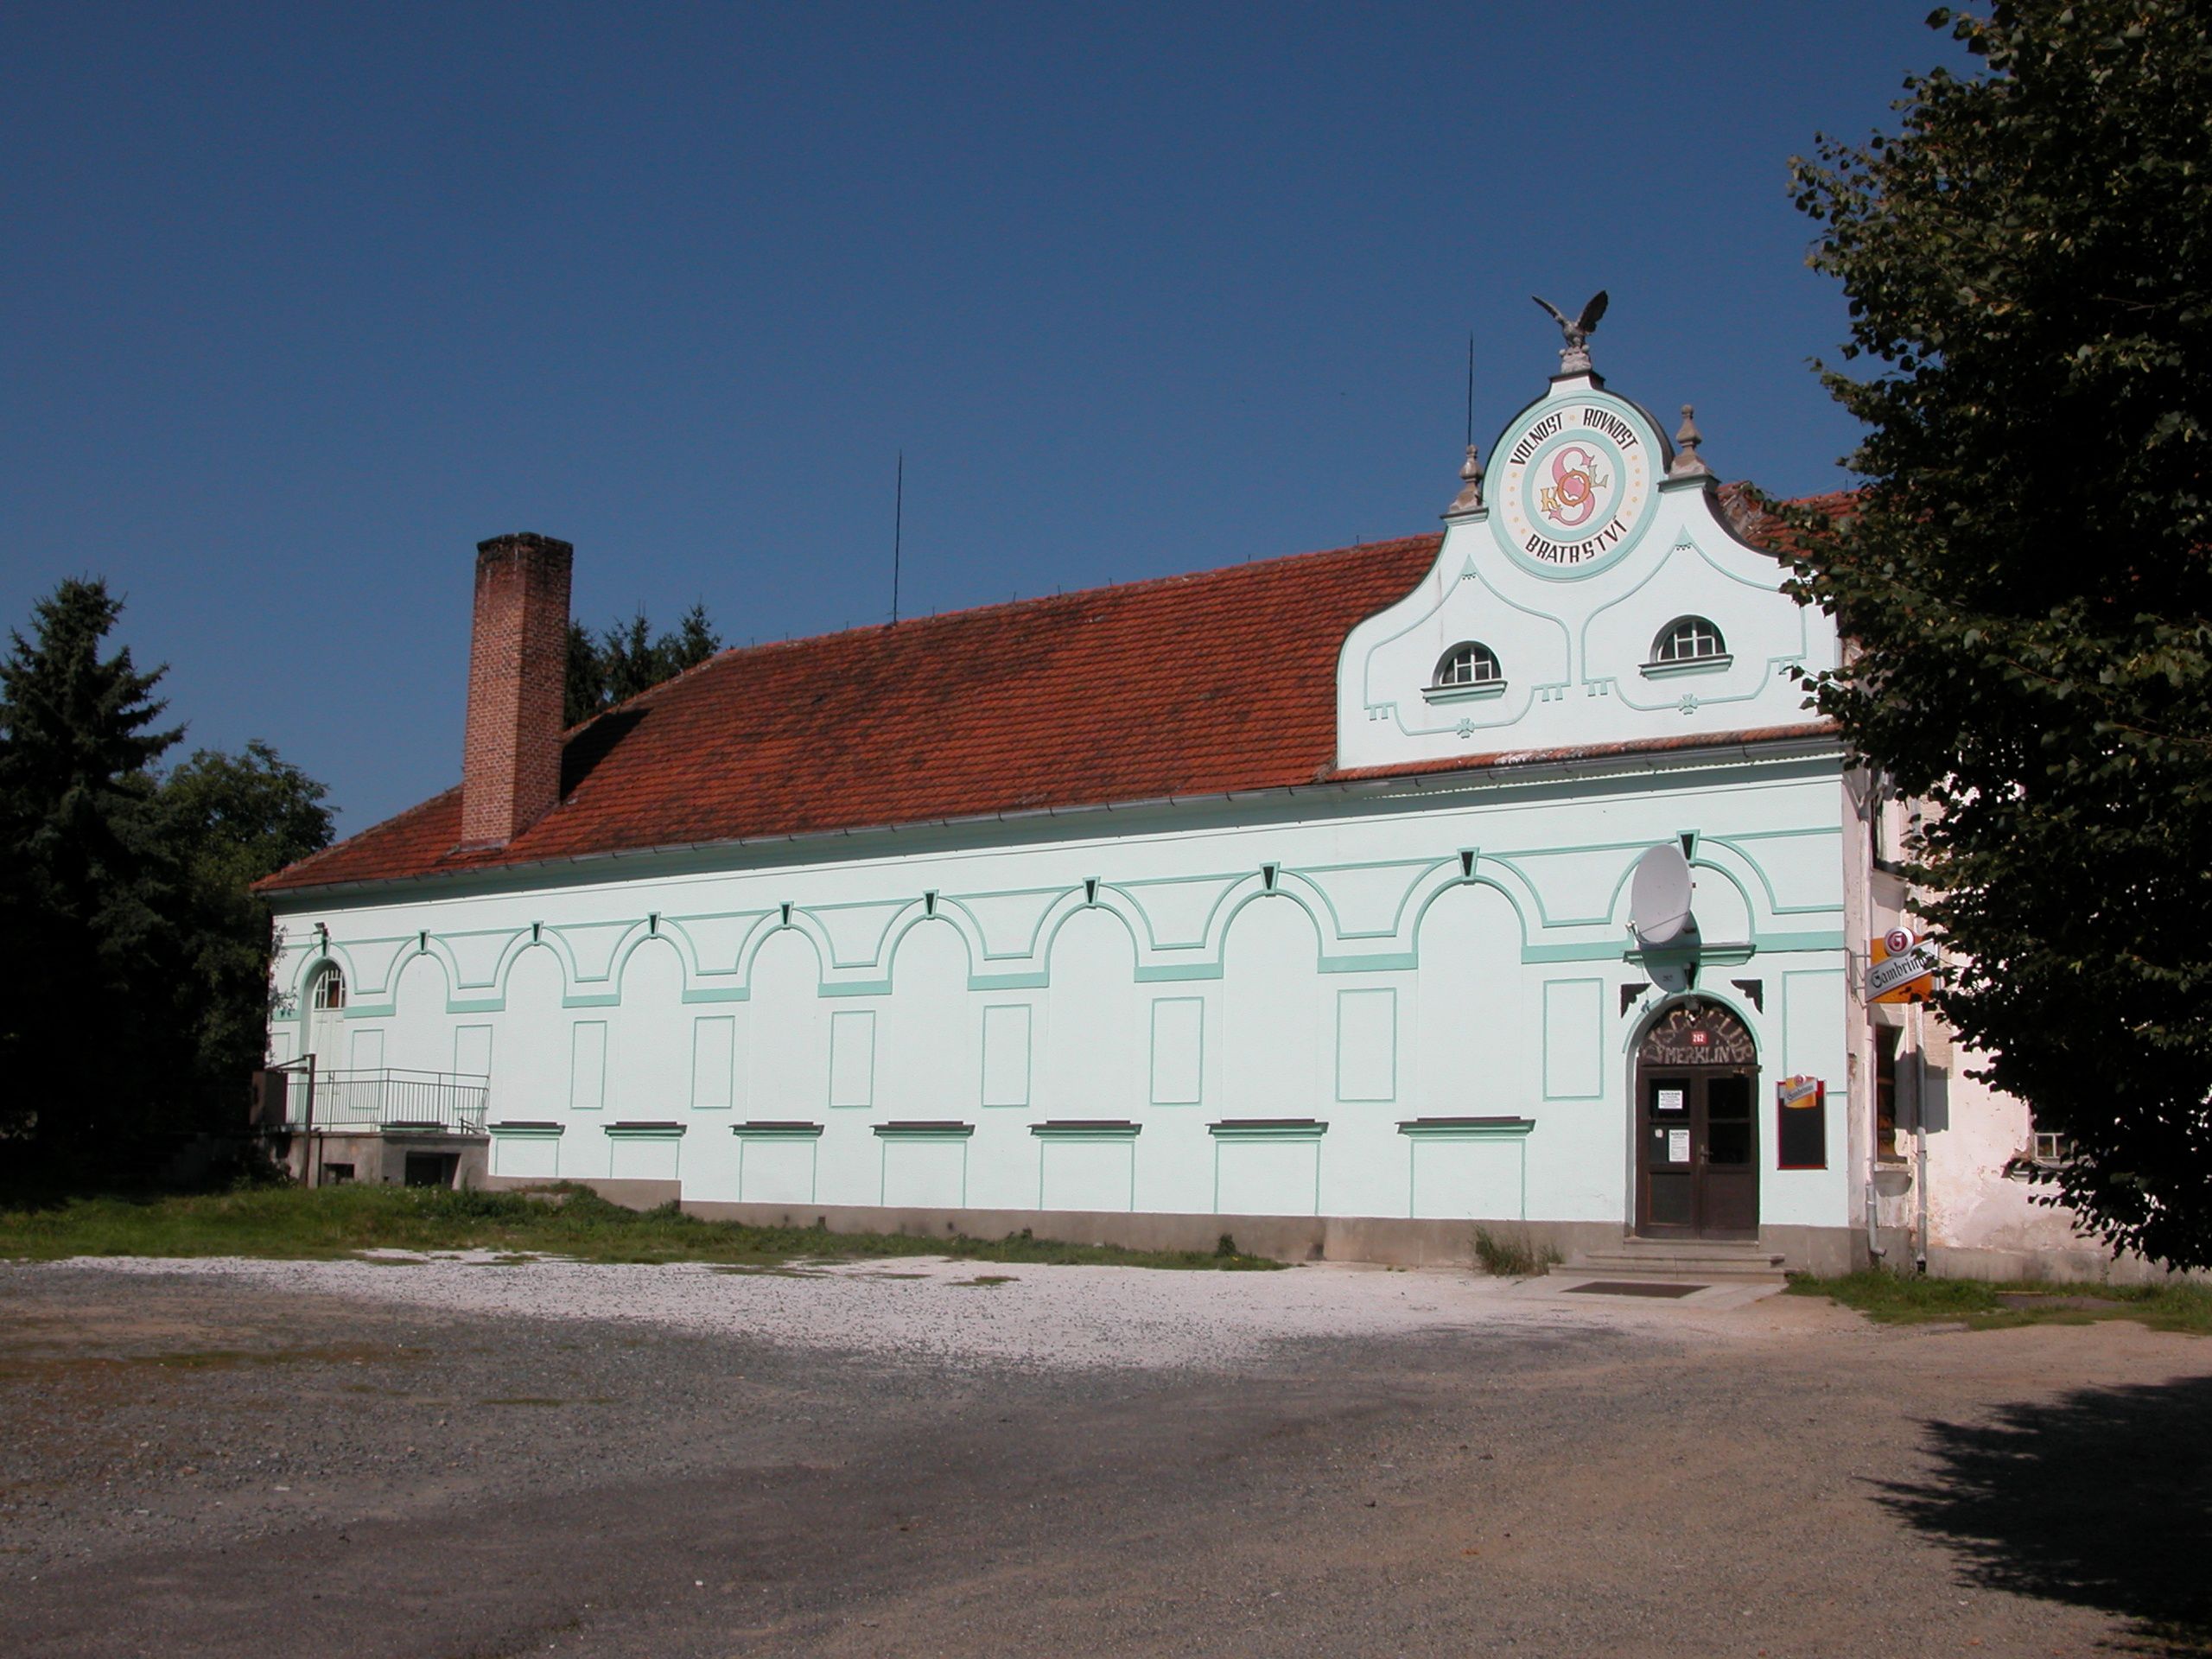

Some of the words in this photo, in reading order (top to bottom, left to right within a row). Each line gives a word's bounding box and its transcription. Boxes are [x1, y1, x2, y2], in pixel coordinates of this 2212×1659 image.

[1510, 412, 1563, 467] VOLNOST
[1583, 408, 1639, 451] ROVNOST
[1525, 515, 1628, 563] BRATRSTVÍ
[1871, 953, 1929, 988] Gambrinu
[1664, 1039, 1731, 1064] MERKLÍN
